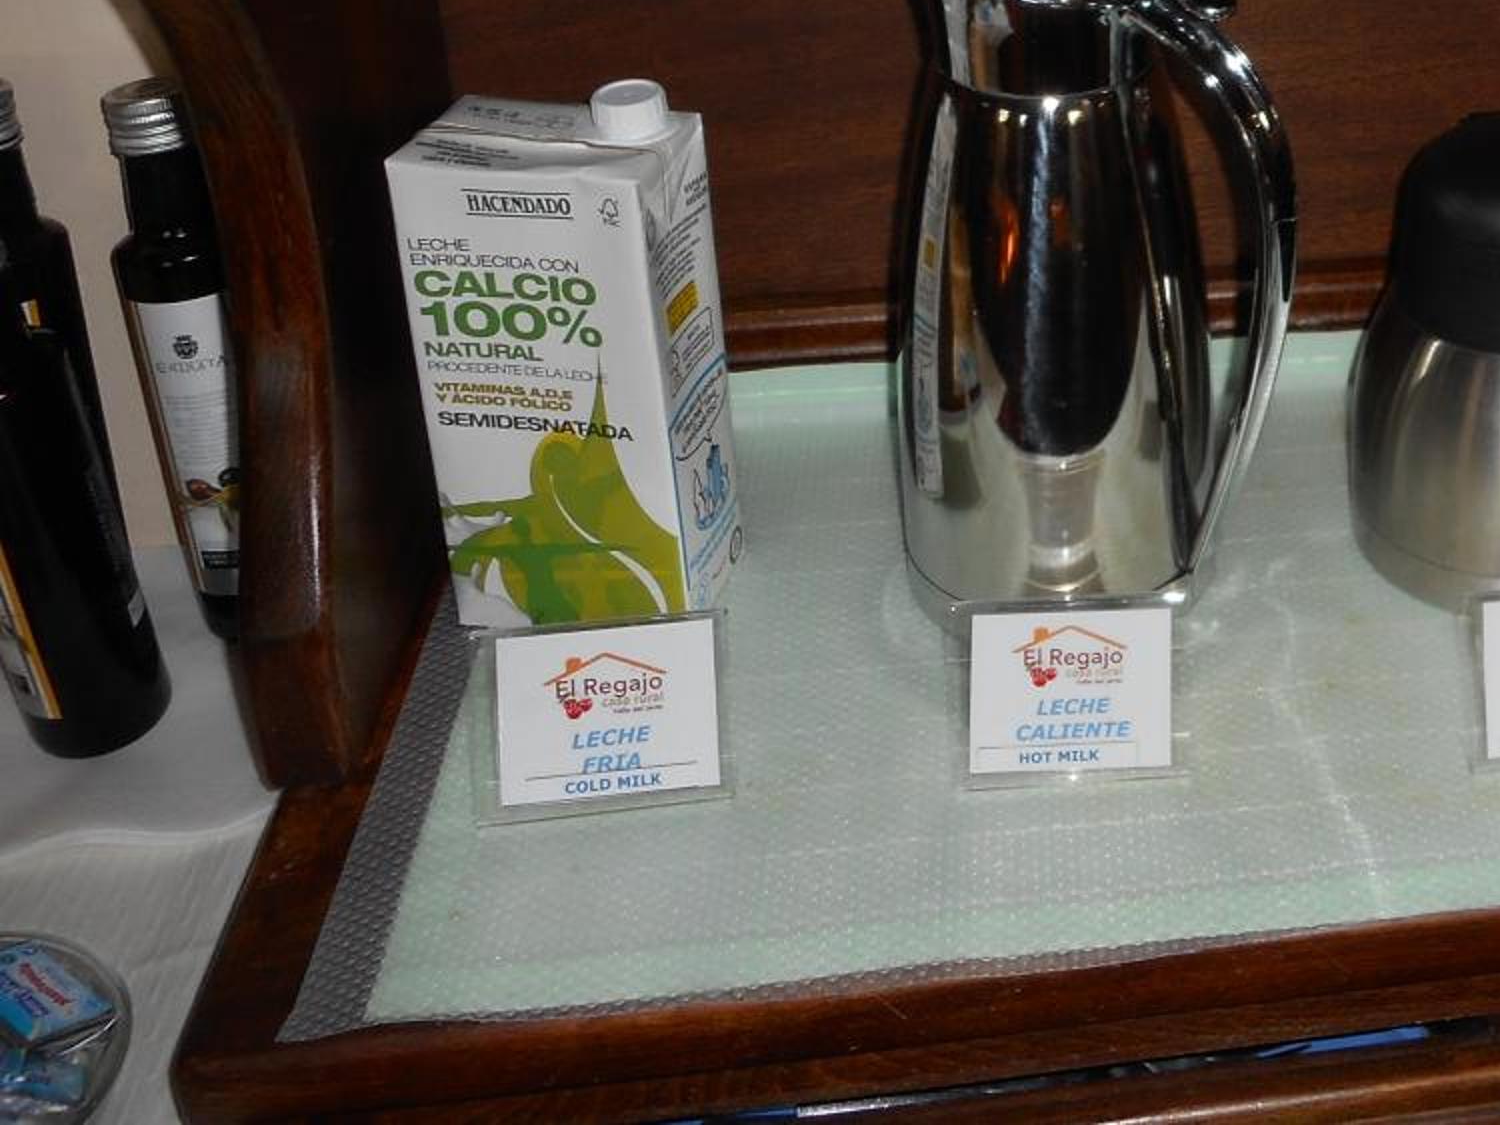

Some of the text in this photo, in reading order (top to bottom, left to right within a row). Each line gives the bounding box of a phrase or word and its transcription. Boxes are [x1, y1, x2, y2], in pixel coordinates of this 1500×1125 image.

[466, 194, 571, 216] HACENDADO
[407, 237, 471, 252] LECHE
[409, 253, 580, 273] ENRIQUECIDA CON
[413, 270, 597, 306] CALCIO
[420, 301, 603, 348] 100%
[424, 341, 543, 362] NATURAL
[427, 360, 522, 376] PROCEDENTE
[524, 365, 544, 378] DE
[545, 367, 563, 379] LA
[434, 382, 526, 396] VITAMINAS
[436, 393, 447, 403] Y
[438, 411, 634, 442] SEMIDESNATADA
[1023, 647, 1124, 671] El Regajo
[555, 673, 663, 701] El Regajo
[1036, 698, 1111, 716] LECHE
[572, 726, 651, 750] LECHE
[1016, 721, 1132, 741] CALIENTE
[1019, 749, 1100, 764] HOT MILK
[565, 774, 661, 794] COLD MILK
